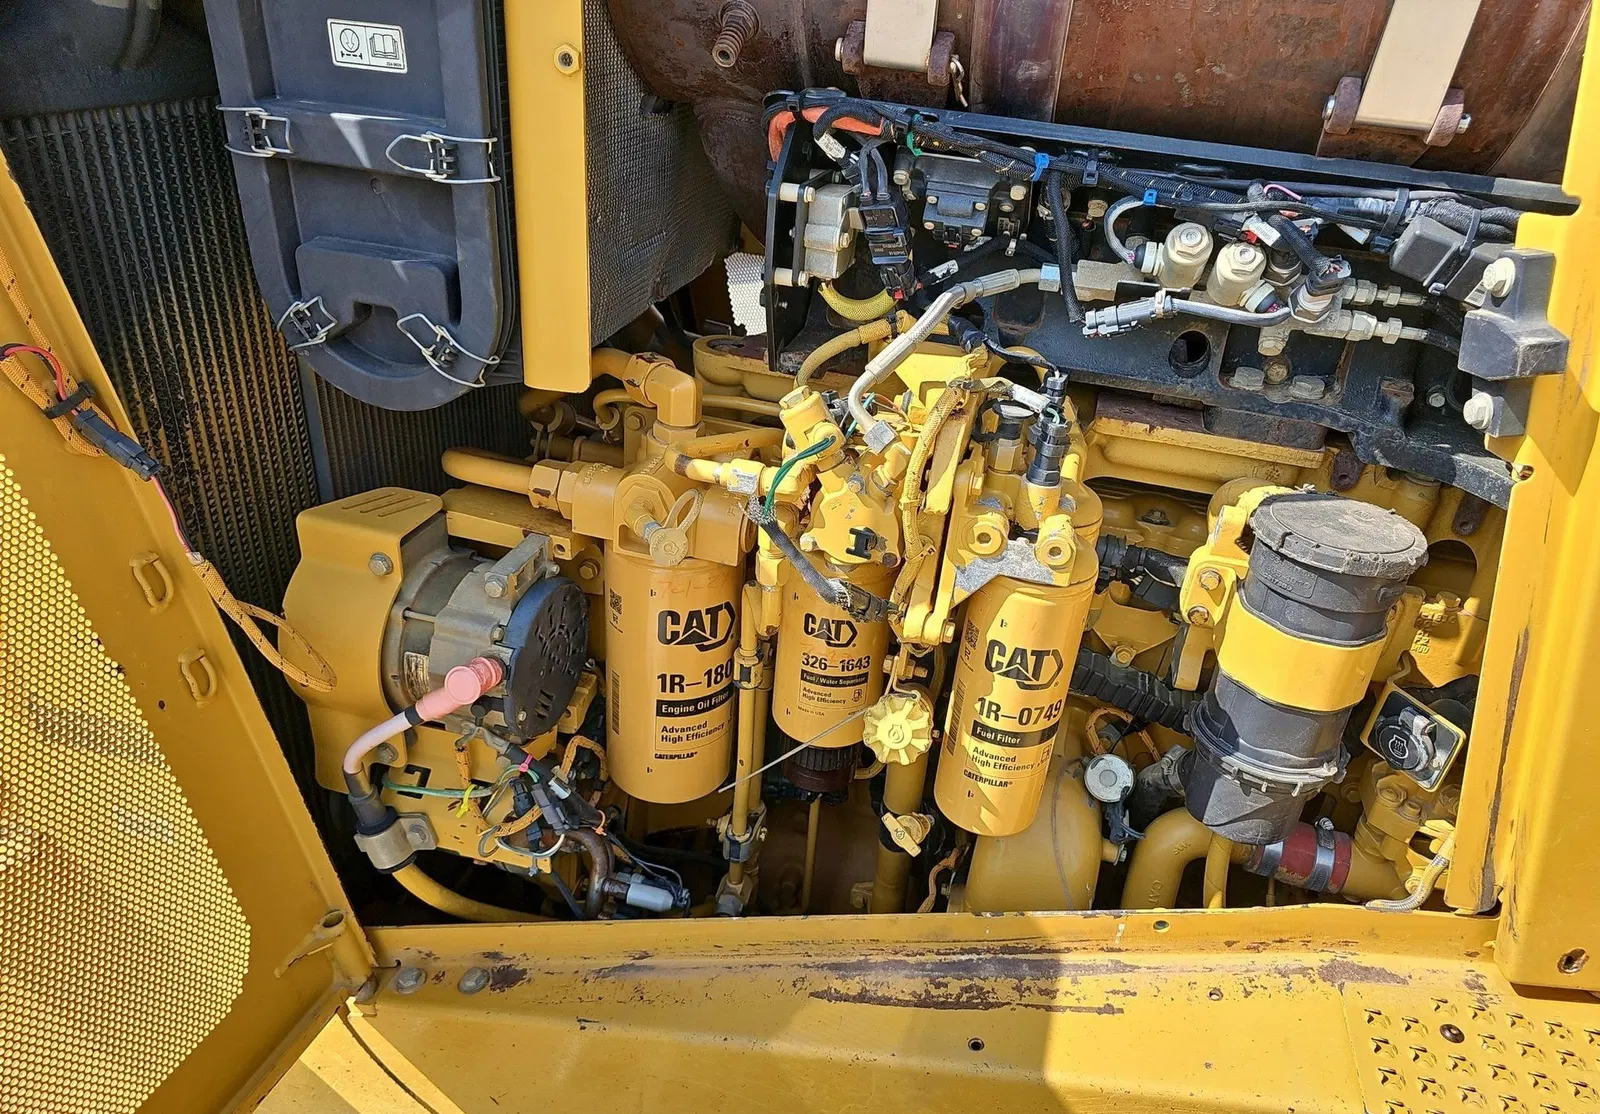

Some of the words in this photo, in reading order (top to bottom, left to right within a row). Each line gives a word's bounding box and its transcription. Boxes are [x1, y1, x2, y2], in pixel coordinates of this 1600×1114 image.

[657, 602, 726, 646] CAT
[803, 613, 847, 642] CAT
[801, 652, 871, 672] 326-1643
[985, 639, 1053, 681] CAT
[803, 673, 815, 682] Fuel
[820, 677, 838, 685] Water
[839, 676, 866, 686] Separator
[802, 687, 832, 698] Advanced
[802, 692, 816, 701] High
[817, 696, 847, 705] Efficiency
[661, 704, 695, 716] Engine
[697, 698, 710, 710] Oil
[711, 691, 729, 706] Filter
[978, 697, 1062, 726] 1R-0749
[660, 734, 684, 744] High
[685, 722, 725, 742] Efficiency
[661, 720, 708, 734] Advanced
[975, 726, 995, 741] Fuel
[997, 733, 1021, 745] Filter
[971, 754, 991, 768] High
[993, 761, 1035, 772] Efficiency
[972, 746, 1017, 763] Advanced
